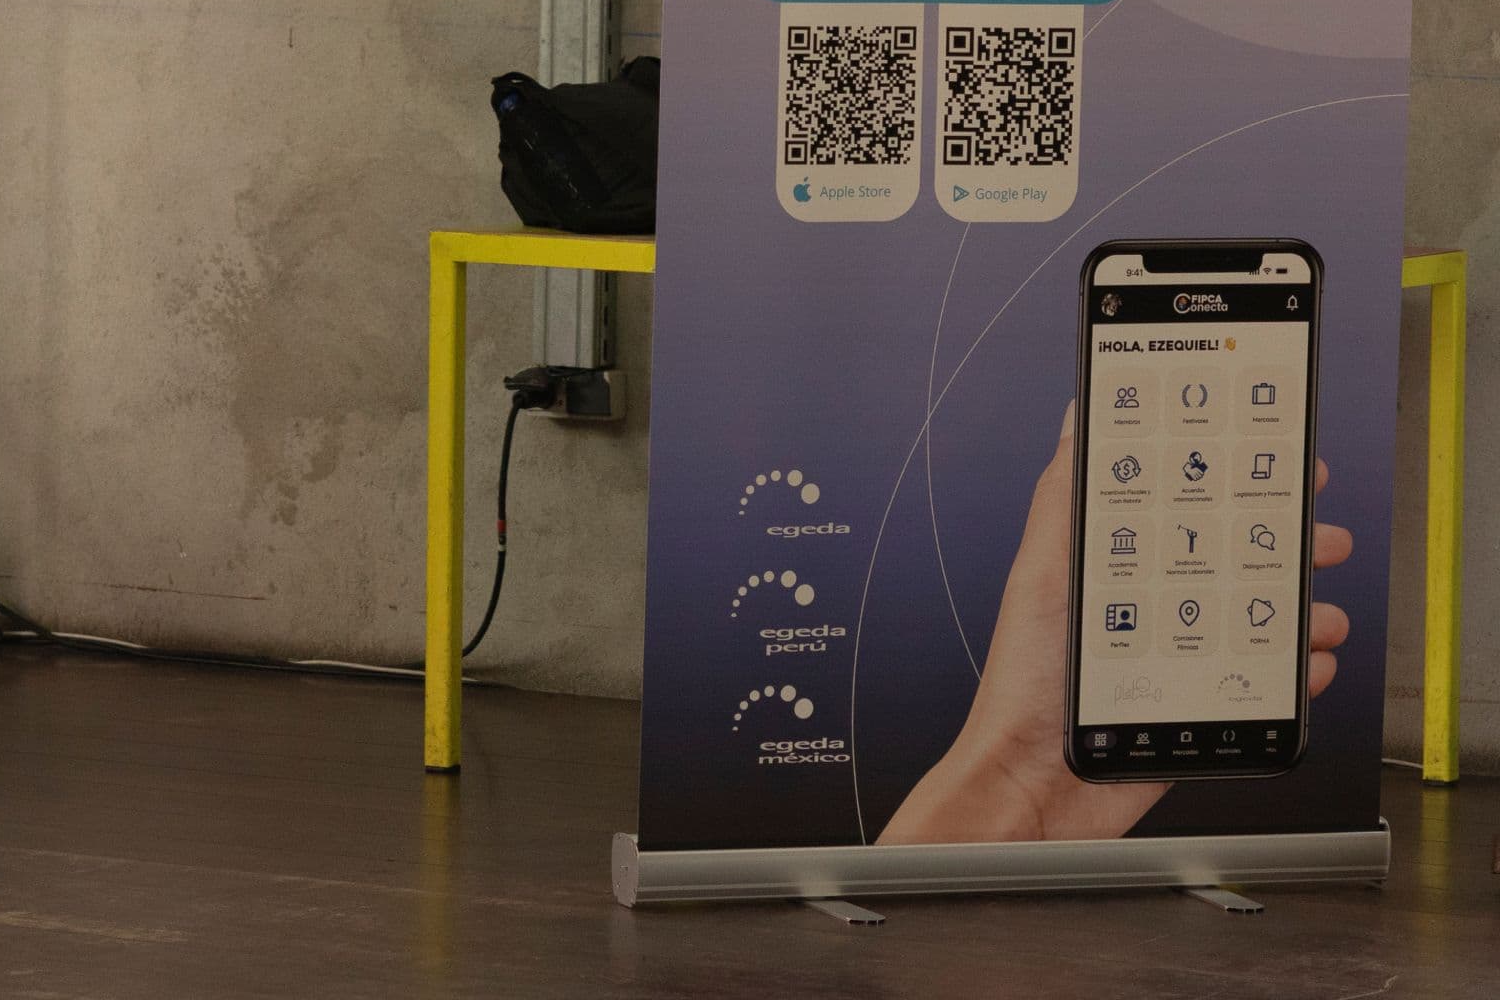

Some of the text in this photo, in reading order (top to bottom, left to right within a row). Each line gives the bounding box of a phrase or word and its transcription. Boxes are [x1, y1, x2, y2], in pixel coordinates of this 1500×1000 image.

[820, 185, 891, 200] Apple Store
[975, 187, 1047, 203] Google Play
[1191, 295, 1222, 303] FIPCA
[1099, 340, 1219, 352] ¡HOLA, EZEQUIEL!
[767, 523, 851, 537] egeda
[760, 625, 846, 640] egeda
[766, 640, 827, 656] perú
[760, 738, 845, 753] egeda
[758, 752, 851, 765] méxico
